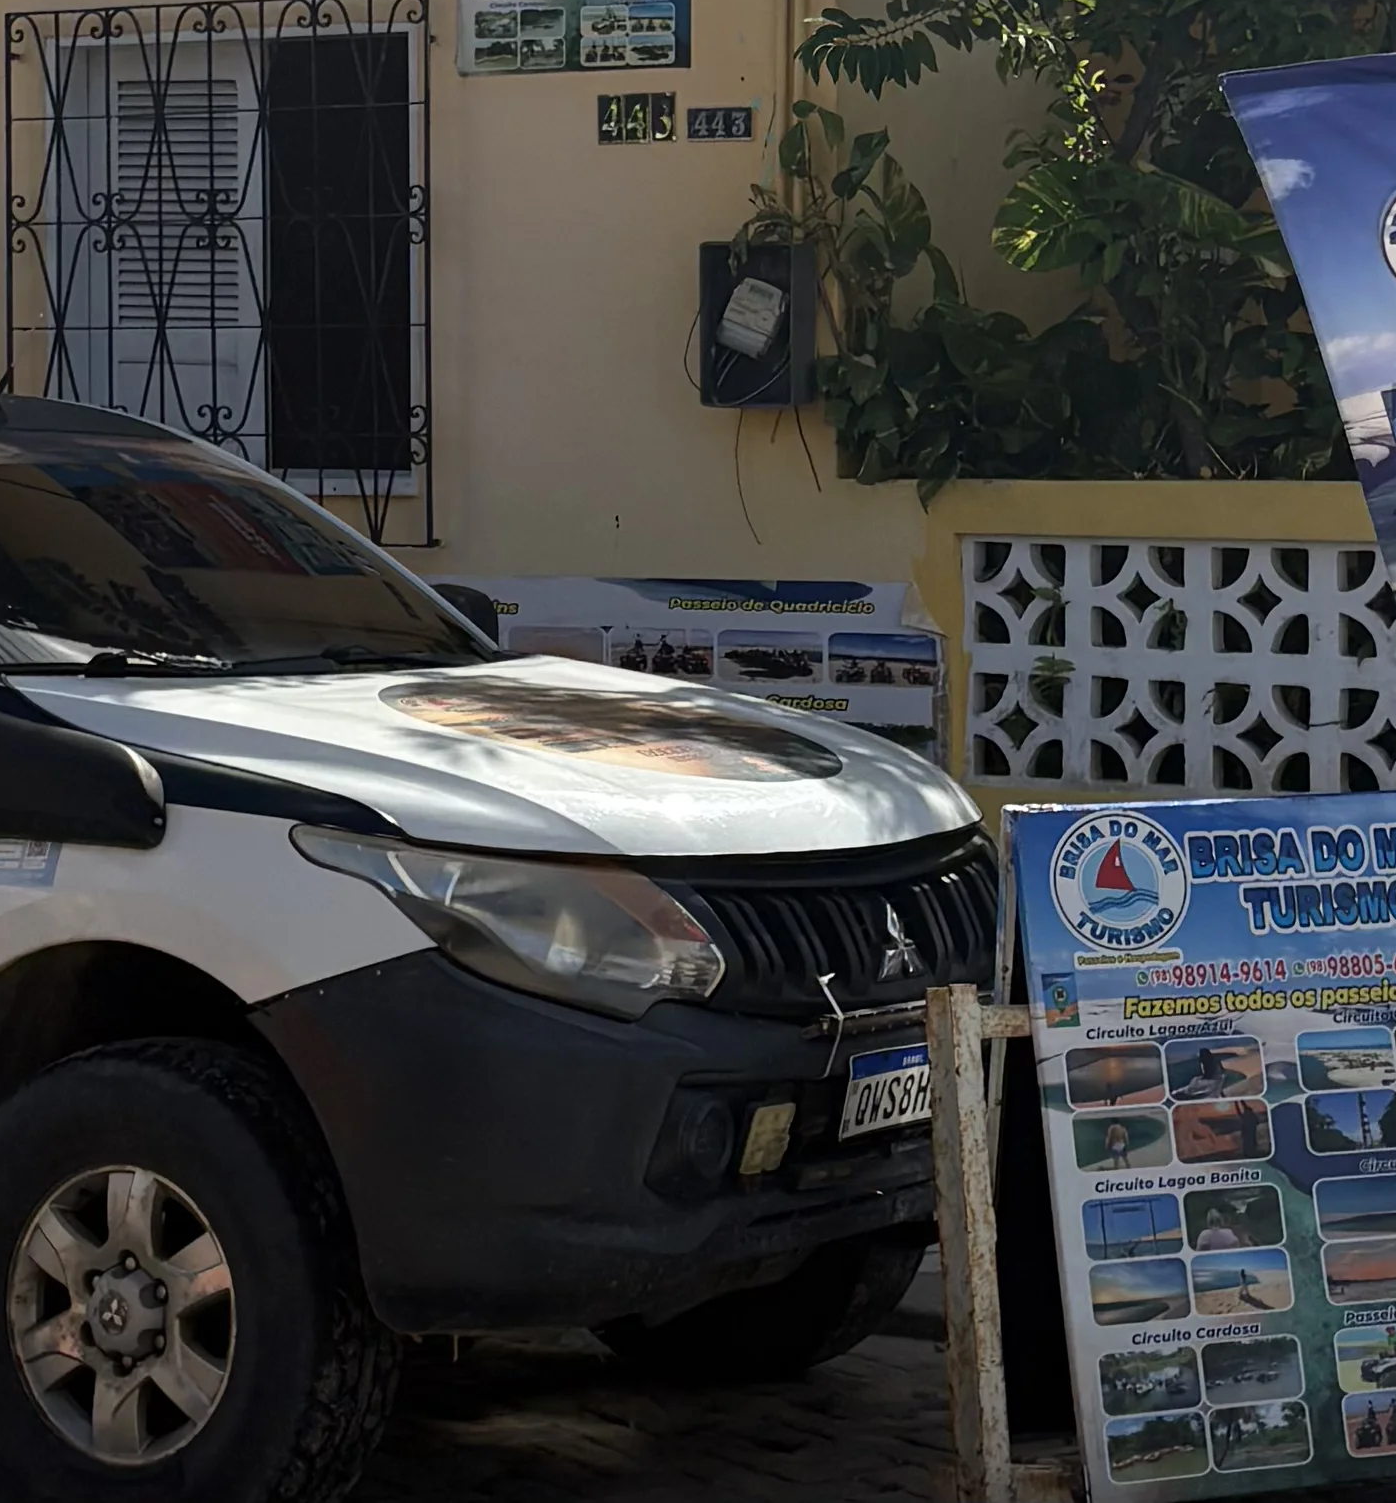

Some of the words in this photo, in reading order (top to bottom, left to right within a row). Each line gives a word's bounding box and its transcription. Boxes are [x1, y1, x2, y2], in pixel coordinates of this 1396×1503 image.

[693, 108, 747, 137] 443
[494, 599, 519, 615] ins
[668, 596, 738, 613] Passeio
[740, 597, 765, 613] de
[769, 596, 875, 615] Quadriciclo
[767, 693, 849, 712] Cardosa
[1059, 824, 1106, 880] BRISA
[1108, 820, 1138, 838] DO
[1142, 830, 1179, 875] MAR
[1189, 832, 1304, 879] BRISA
[1312, 825, 1366, 875] DO
[1076, 907, 1174, 946] TURISMO
[1124, 994, 1221, 1020] Fazemos
[1224, 986, 1285, 1012] todos
[1290, 989, 1318, 1009] os
[1333, 1009, 1389, 1024] Circuito
[1086, 1026, 1144, 1040] Circuito
[1094, 1176, 1155, 1193] Circuito
[1158, 1172, 1206, 1191] Lagoa
[1210, 1169, 1262, 1185] Bonita
[1131, 1327, 1192, 1345] Circuito
[1196, 1322, 1261, 1340] Cardosa
